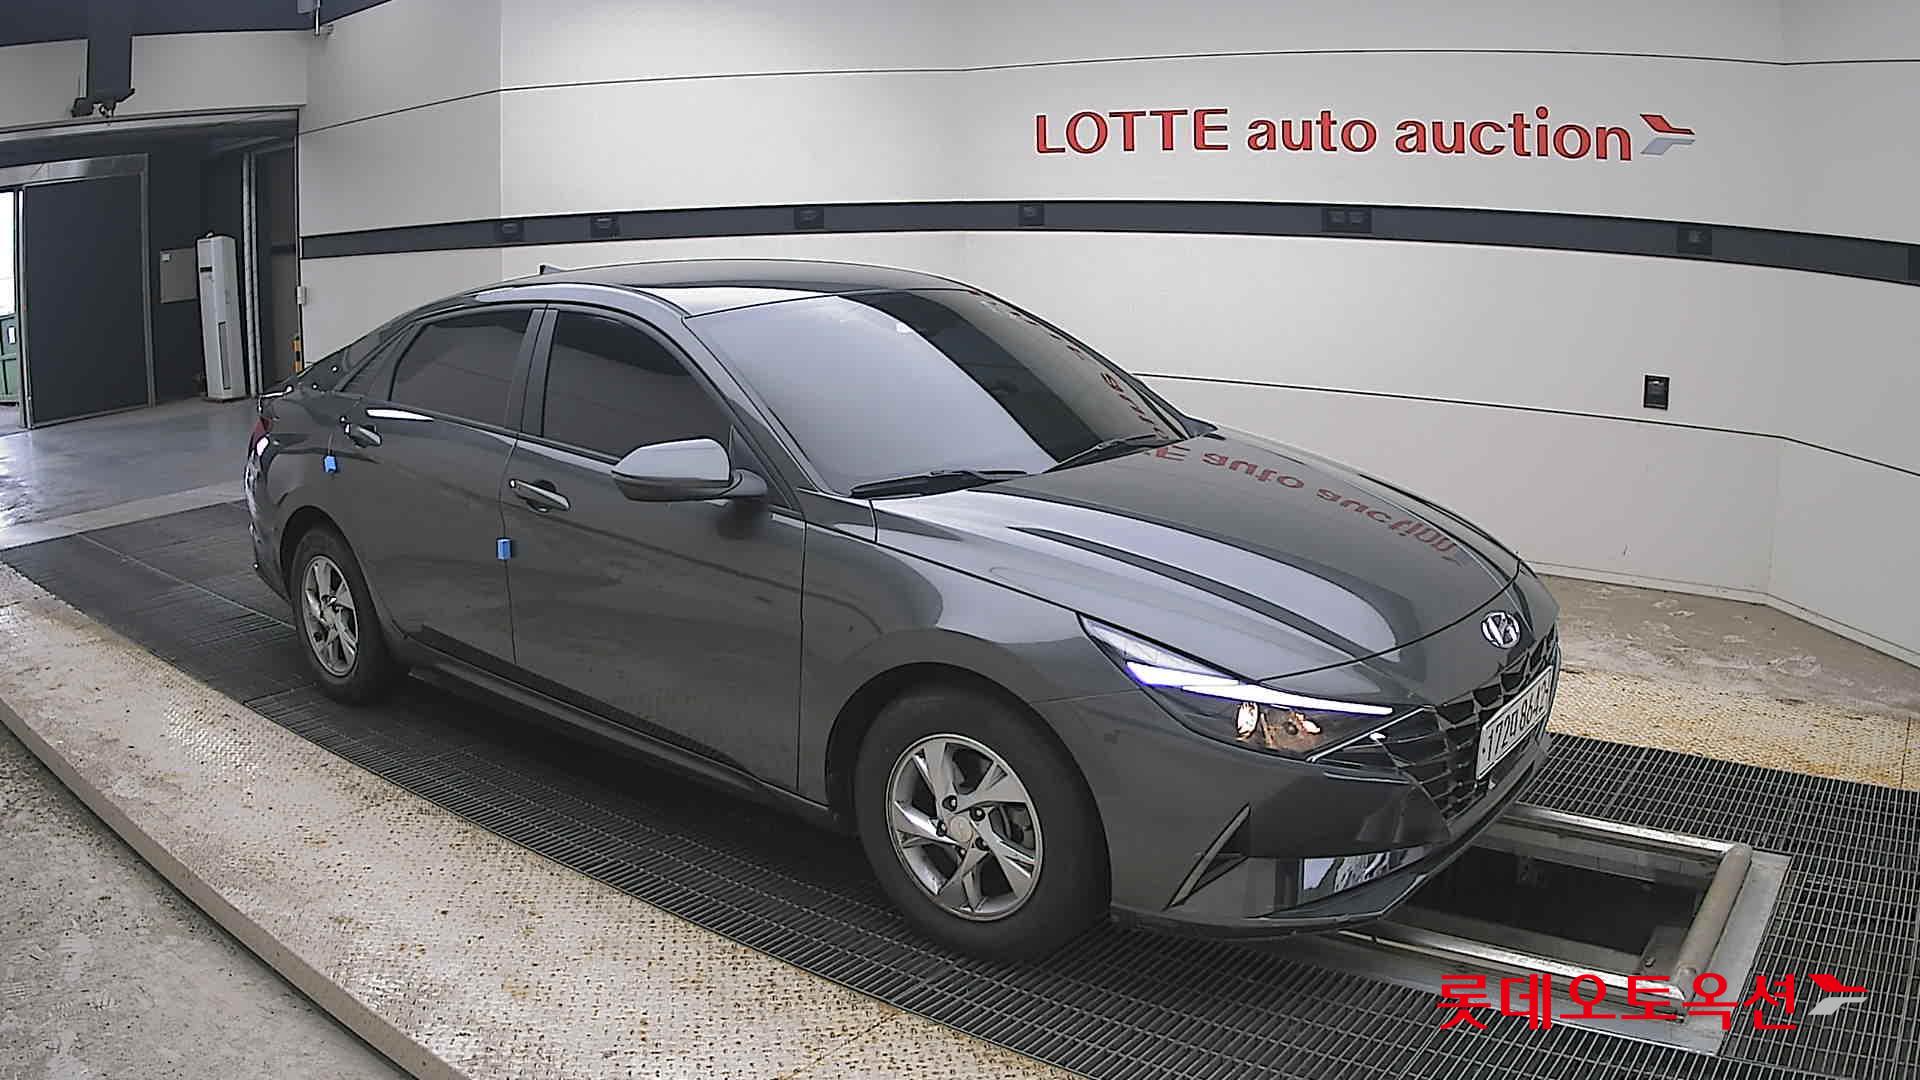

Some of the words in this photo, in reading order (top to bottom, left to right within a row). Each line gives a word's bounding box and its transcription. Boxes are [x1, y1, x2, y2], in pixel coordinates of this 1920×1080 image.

[1035, 108, 1228, 154] LOTTE
[1247, 110, 1377, 152] auto
[1394, 106, 1633, 161] auction
